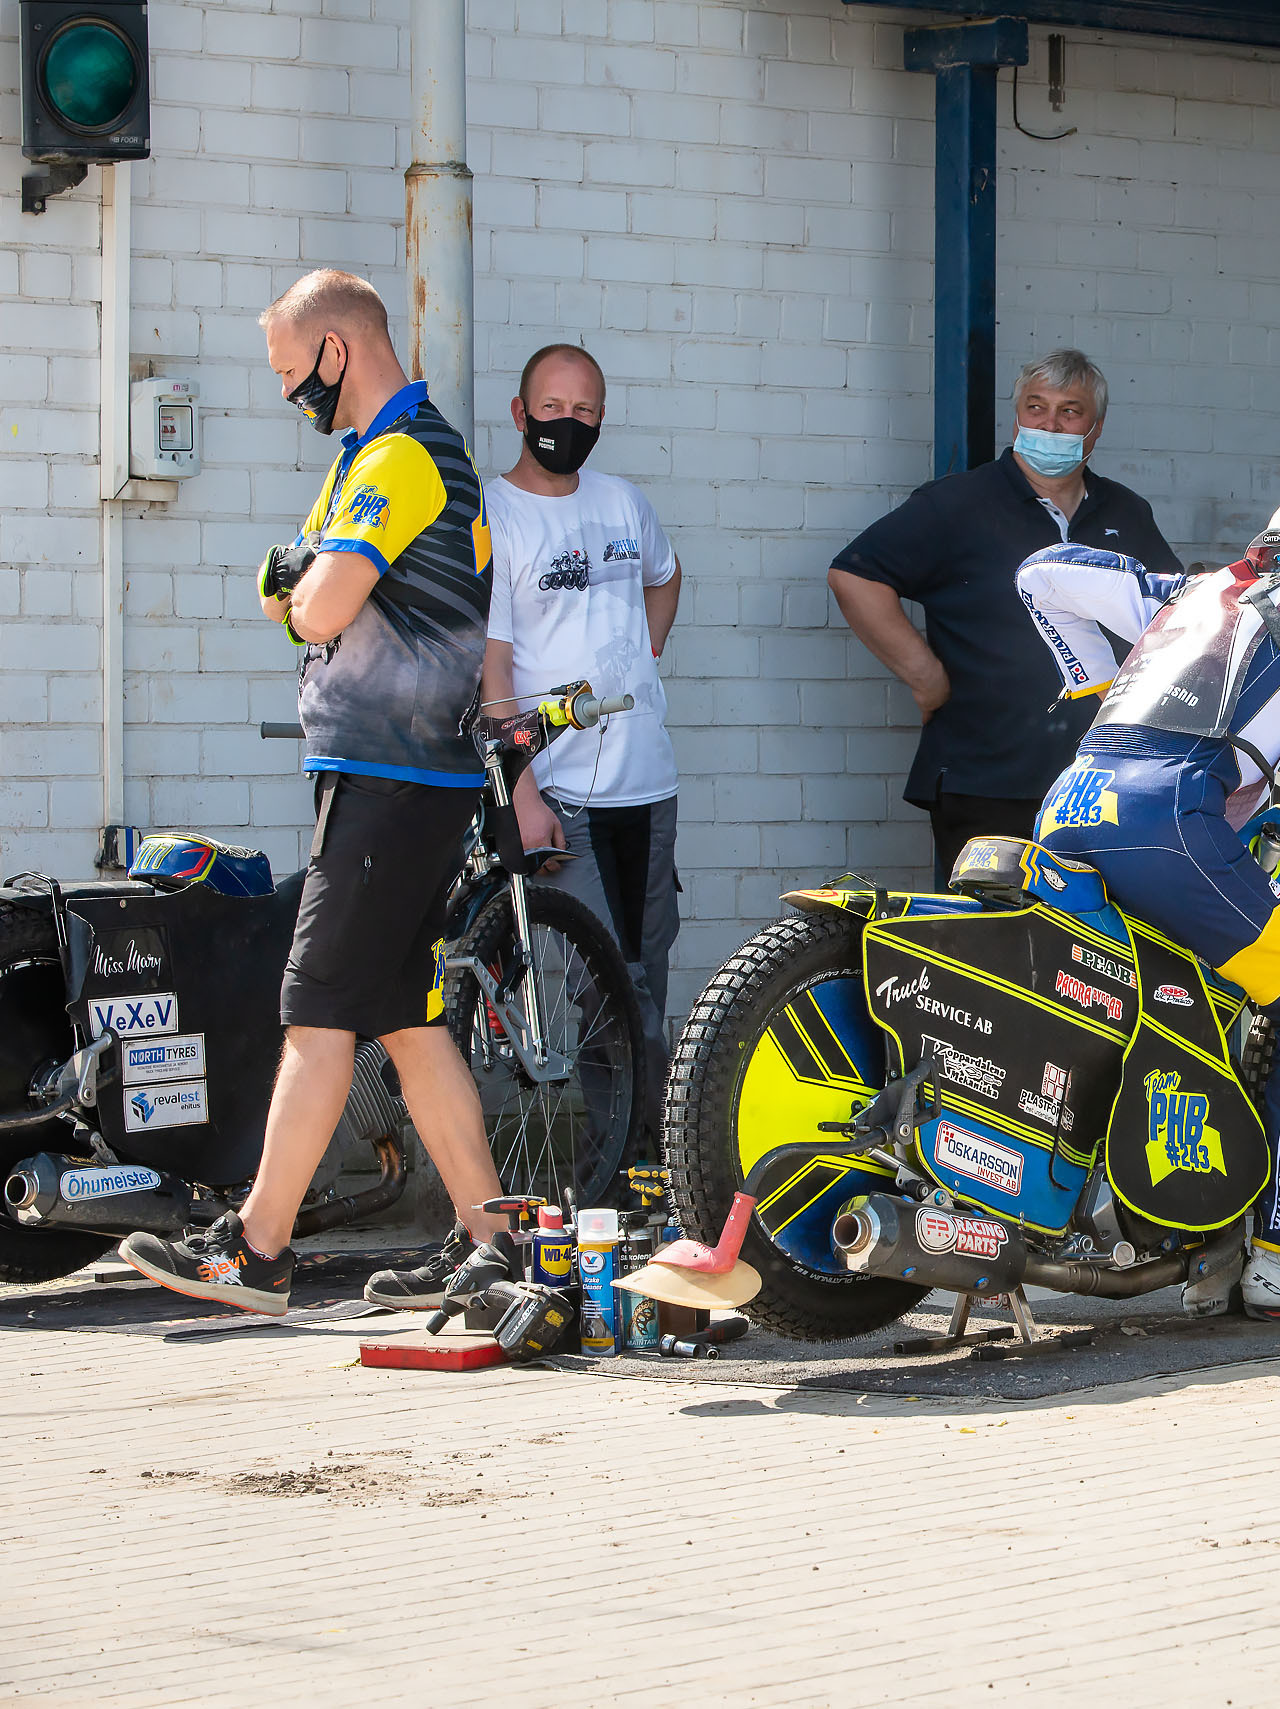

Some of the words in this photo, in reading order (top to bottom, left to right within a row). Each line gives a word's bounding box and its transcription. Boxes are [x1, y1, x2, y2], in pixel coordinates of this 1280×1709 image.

[1050, 771, 1114, 807] PHB
[1054, 806, 1103, 825] #243
[965, 847, 996, 863] PHB
[93, 945, 124, 977] Miss
[125, 940, 162, 976] Mary
[1081, 948, 1131, 983] PEAB
[875, 966, 931, 1008] Truck
[1056, 971, 1092, 1008] PACORA
[1092, 988, 1110, 1006] BYGG
[1107, 999, 1122, 1019] AB
[95, 1000, 172, 1031] VeXeV
[916, 995, 972, 1027] SERVICE
[973, 1017, 993, 1035] AB
[130, 1049, 163, 1064] NORTH
[166, 1046, 197, 1060] TYRES
[154, 1091, 199, 1106] revalest
[948, 1069, 998, 1099] Mekaniska
[1144, 1070, 1179, 1098] Team
[1150, 1092, 1207, 1145] PHB
[947, 1139, 1018, 1180] OSKARSSON
[1164, 1140, 1210, 1169] #243
[68, 1171, 153, 1197] Õhumeister
[977, 1166, 1004, 1184] INVEST
[1006, 1178, 1017, 1190] AB
[955, 1217, 1005, 1240] RACING
[957, 1233, 998, 1254] PARTS
[196, 1250, 248, 1282] Sievi
